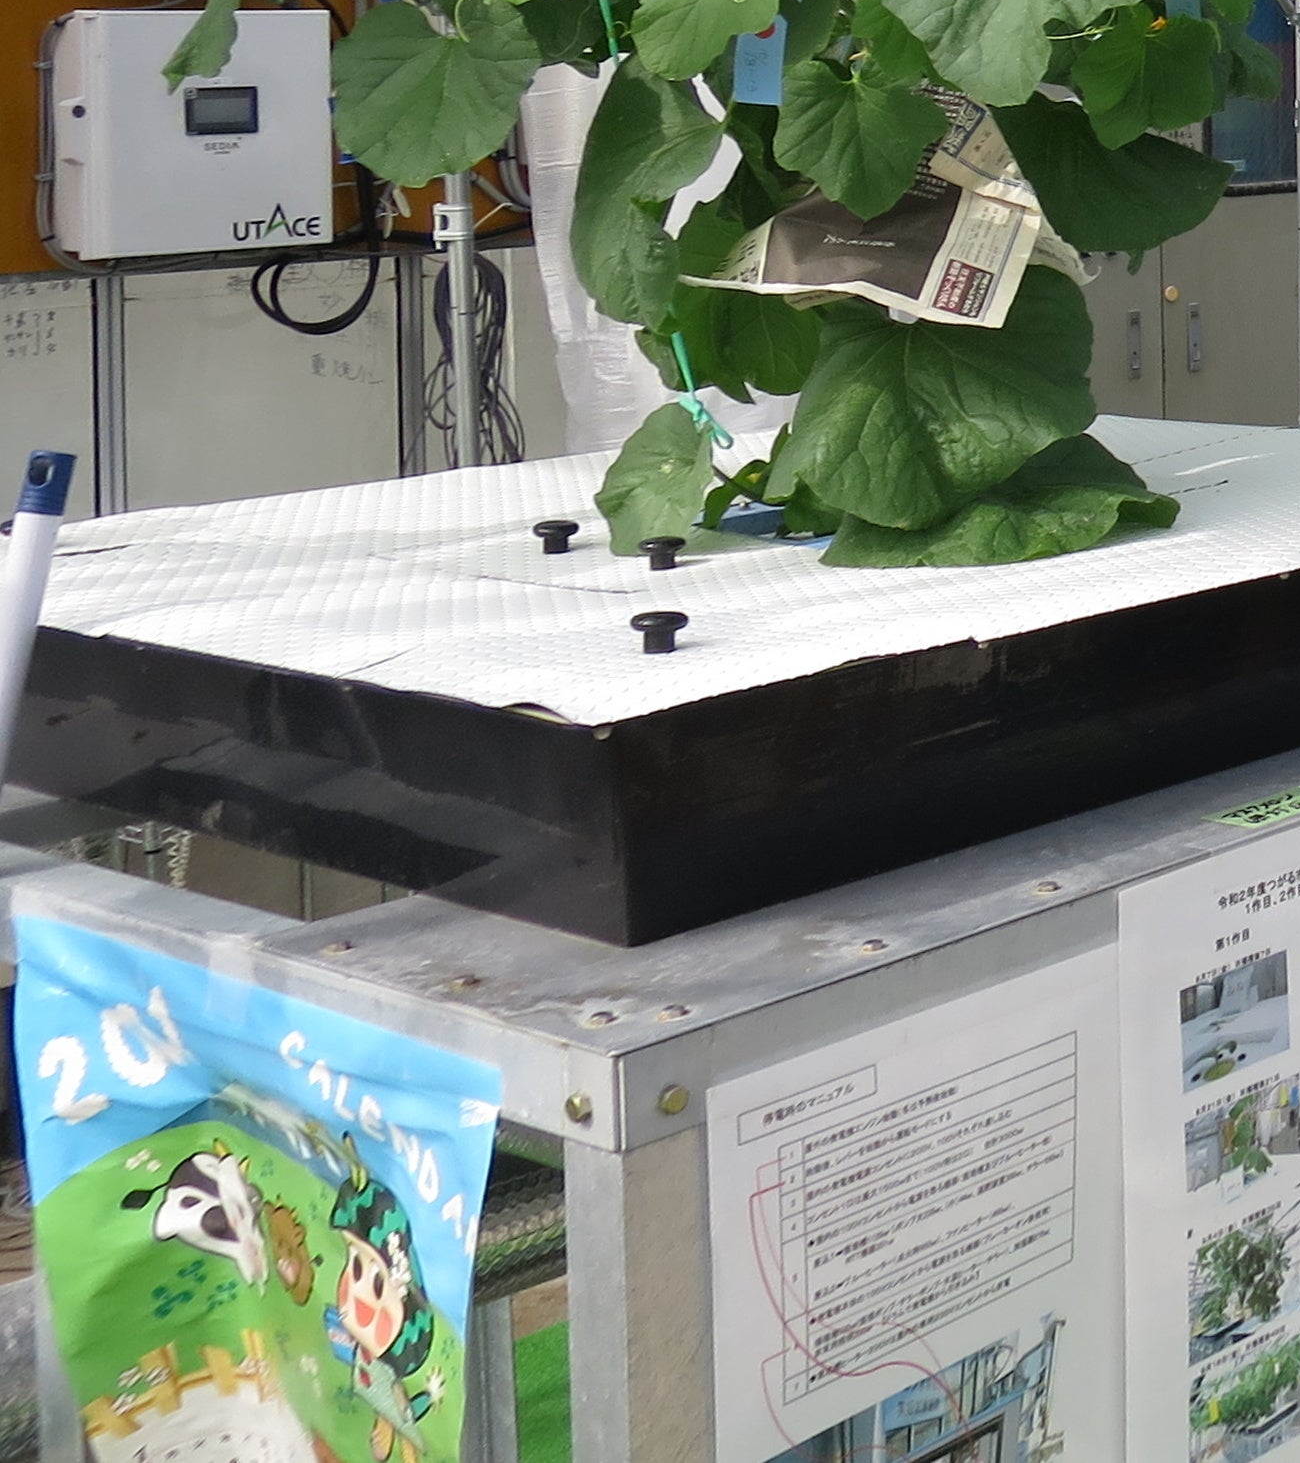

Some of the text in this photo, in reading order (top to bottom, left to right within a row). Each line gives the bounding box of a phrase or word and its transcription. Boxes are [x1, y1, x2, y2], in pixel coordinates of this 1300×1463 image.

[232, 203, 321, 242] UTACE
[1215, 927, 1250, 952] 第1作目
